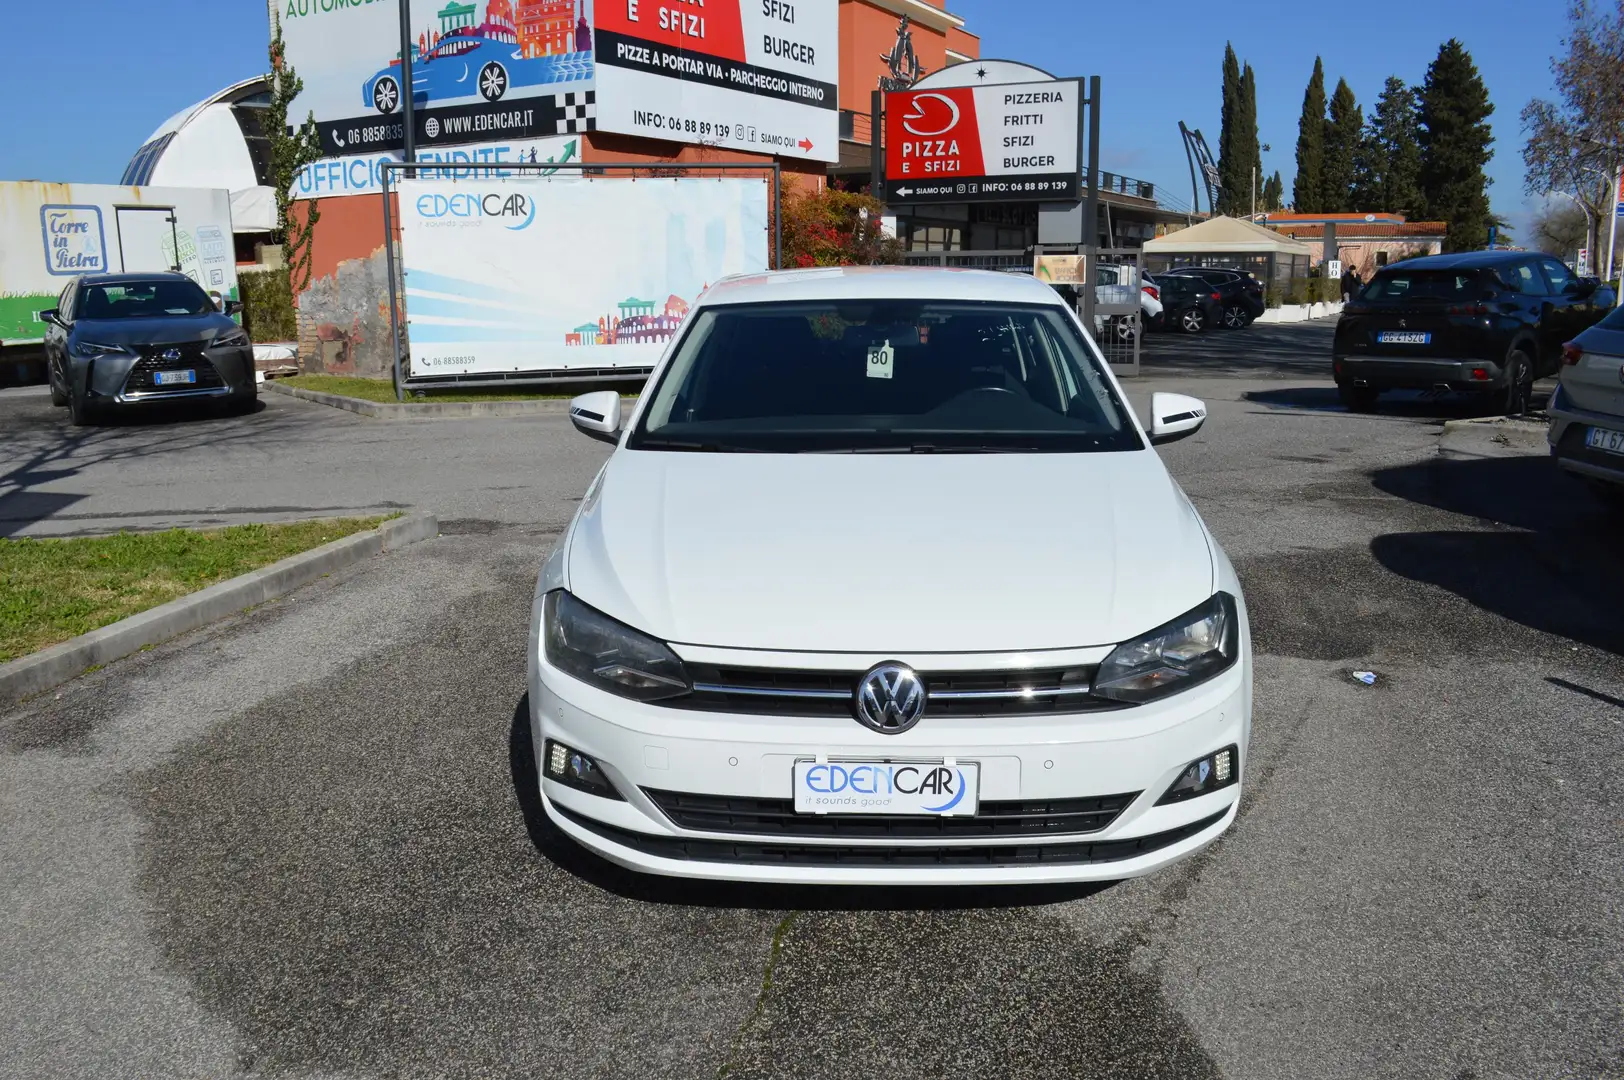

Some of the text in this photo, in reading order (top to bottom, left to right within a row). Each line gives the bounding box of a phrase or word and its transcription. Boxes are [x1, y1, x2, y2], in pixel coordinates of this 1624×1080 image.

[628, 0, 705, 39] E SFIZI
[763, 0, 794, 24] SFIZI
[764, 34, 815, 66] BURGER
[617, 42, 824, 101] PIZZE A PORTAR VIA PARCHEGGIO INTERNO
[1004, 91, 1063, 105] PIZZERIA
[443, 110, 534, 134] WWW.EDENCAR.IT
[634, 110, 730, 138] INFO: 06 88 89 139
[1003, 114, 1043, 127] FRITTI
[348, 123, 405, 144] 06 8858835
[761, 133, 796, 148] SIAMO QUI
[1003, 135, 1034, 148] SFIZI
[902, 139, 960, 158] PIZZA
[902, 160, 960, 173] E SFIZI
[1003, 155, 1055, 169] BURGER
[299, 156, 396, 193] UFFICIO
[916, 187, 953, 195] SIAMO QUI
[982, 181, 1067, 192] INFO: 06 88 89 139
[416, 193, 527, 217] EDENCAR
[50, 212, 88, 234] Torre
[53, 234, 68, 248] in
[56, 248, 99, 268] Pietra
[433, 356, 476, 365] 06 88588359
[871, 351, 888, 365] 80
[806, 765, 954, 795] EDENCAR
[805, 795, 812, 805] it
[815, 796, 857, 805] sounds
